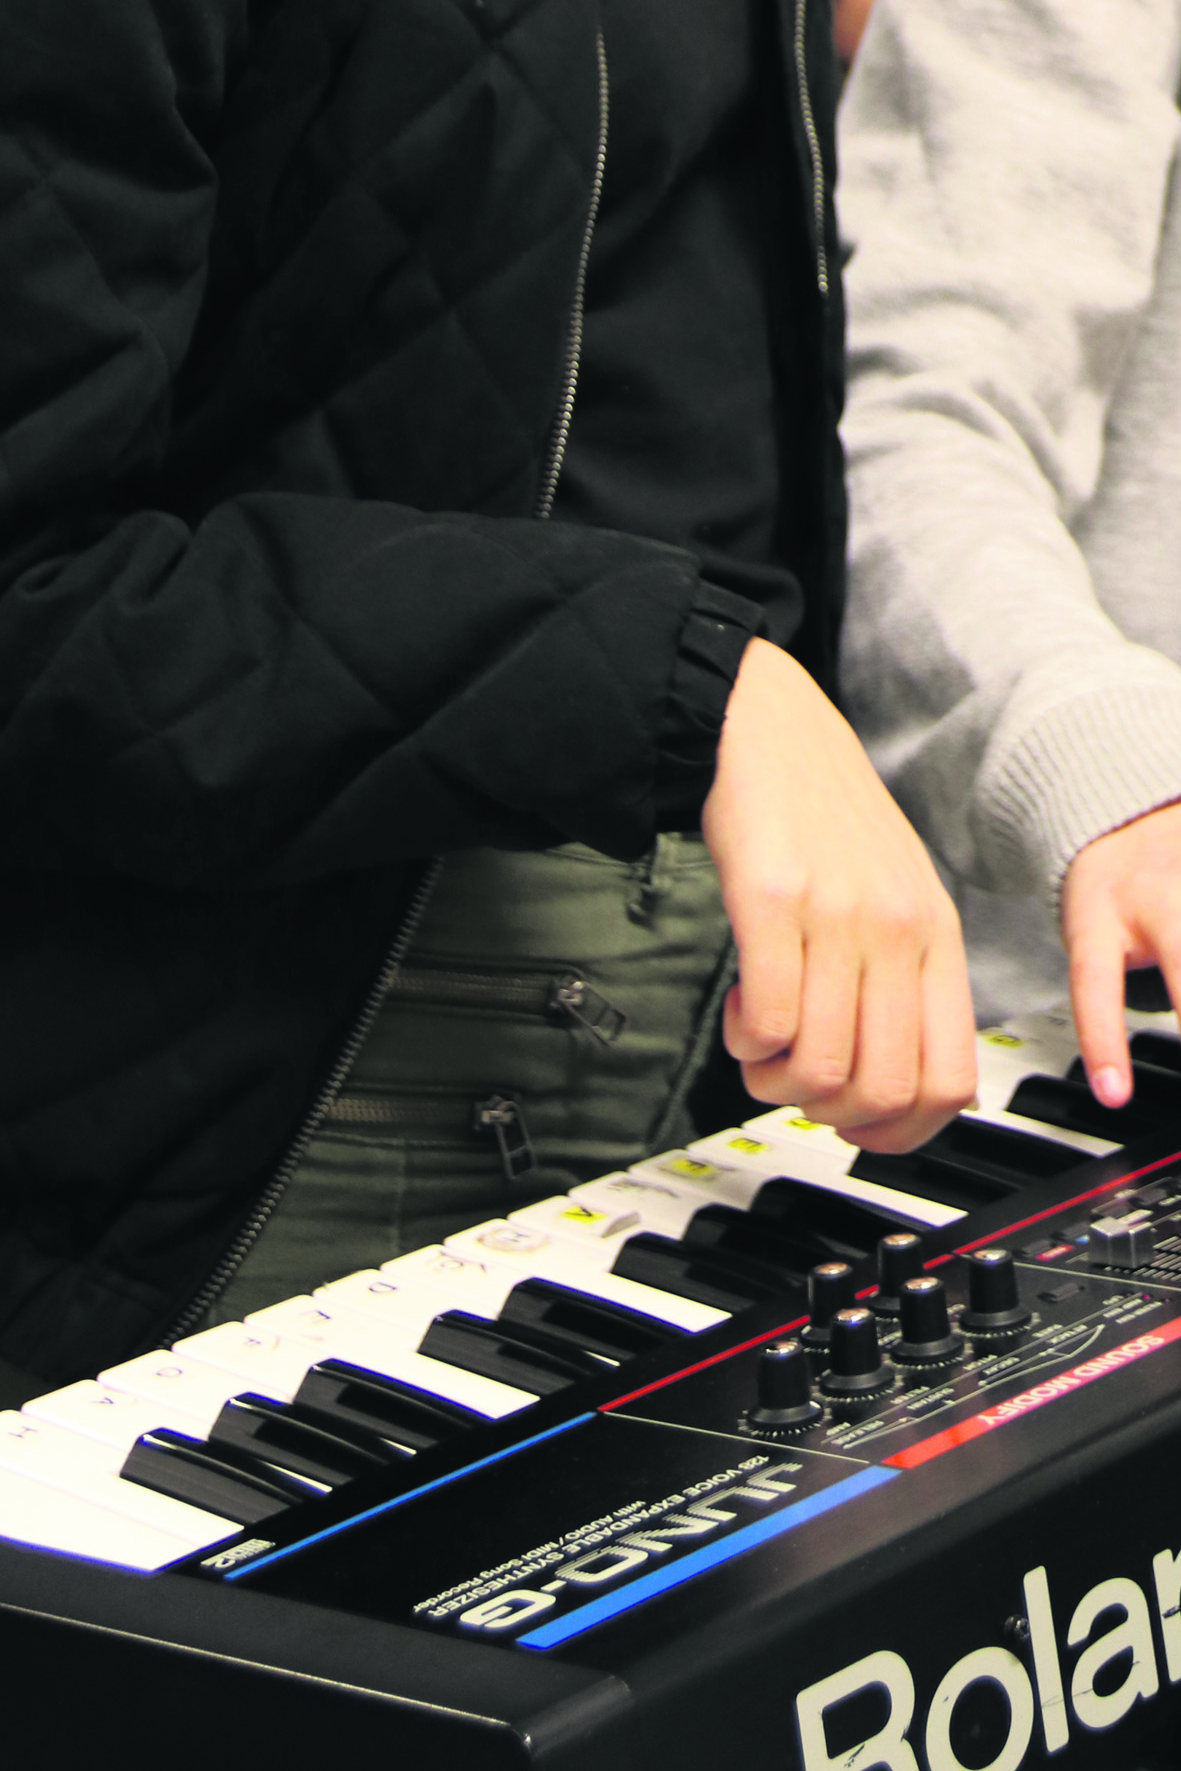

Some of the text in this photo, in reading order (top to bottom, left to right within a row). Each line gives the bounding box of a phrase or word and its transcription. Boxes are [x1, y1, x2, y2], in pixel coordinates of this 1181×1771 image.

[1076, 1334, 1165, 1376] SOUND
[976, 1369, 1080, 1426] MODIFY
[683, 1467, 742, 1497] VOICE
[563, 1492, 686, 1555] EXPANDABLE
[613, 1499, 647, 1518] with
[459, 1462, 804, 1630] JUNO-G
[428, 1546, 566, 1618] SYNTHESIZER
[479, 1558, 524, 1581] Song
[411, 1573, 483, 1614] Recorder
